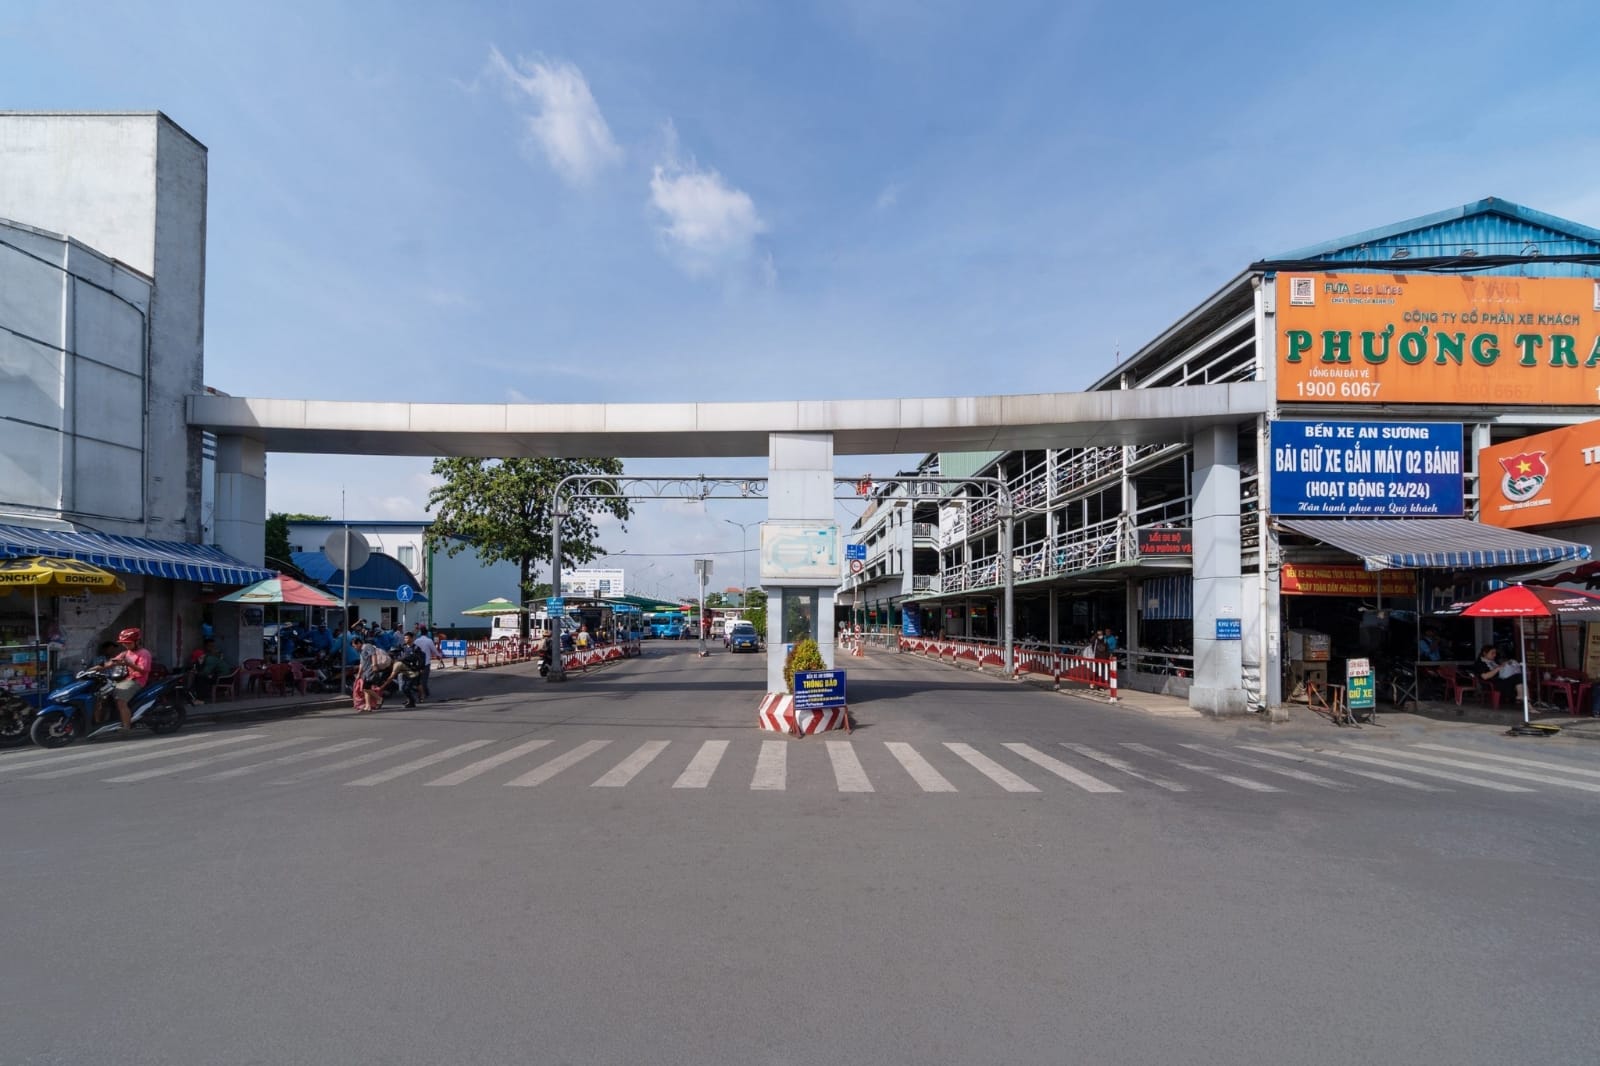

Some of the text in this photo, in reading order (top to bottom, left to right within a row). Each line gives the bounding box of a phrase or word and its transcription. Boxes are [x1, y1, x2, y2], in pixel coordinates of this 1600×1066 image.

[1325, 283, 1350, 294] FUTA
[1403, 310, 1438, 322] CÔNG
[1442, 312, 1457, 323] TY
[1518, 313, 1534, 324] XE
[1538, 311, 1580, 325] KHÁCH
[1285, 323, 1501, 366] PHƯƠNG
[1297, 382, 1381, 397] 1900 6067
[1305, 423, 1429, 439] BẾN XE AN SƯƠNG
[1276, 441, 1459, 474] BÃI GIỮ XE GẮN MÁY 02 BÁNH
[1306, 479, 1430, 500] (HOẠT ĐỘNG 24/24)
[1410, 503, 1438, 513] khách
[65, 575, 104, 583] BONCHA
